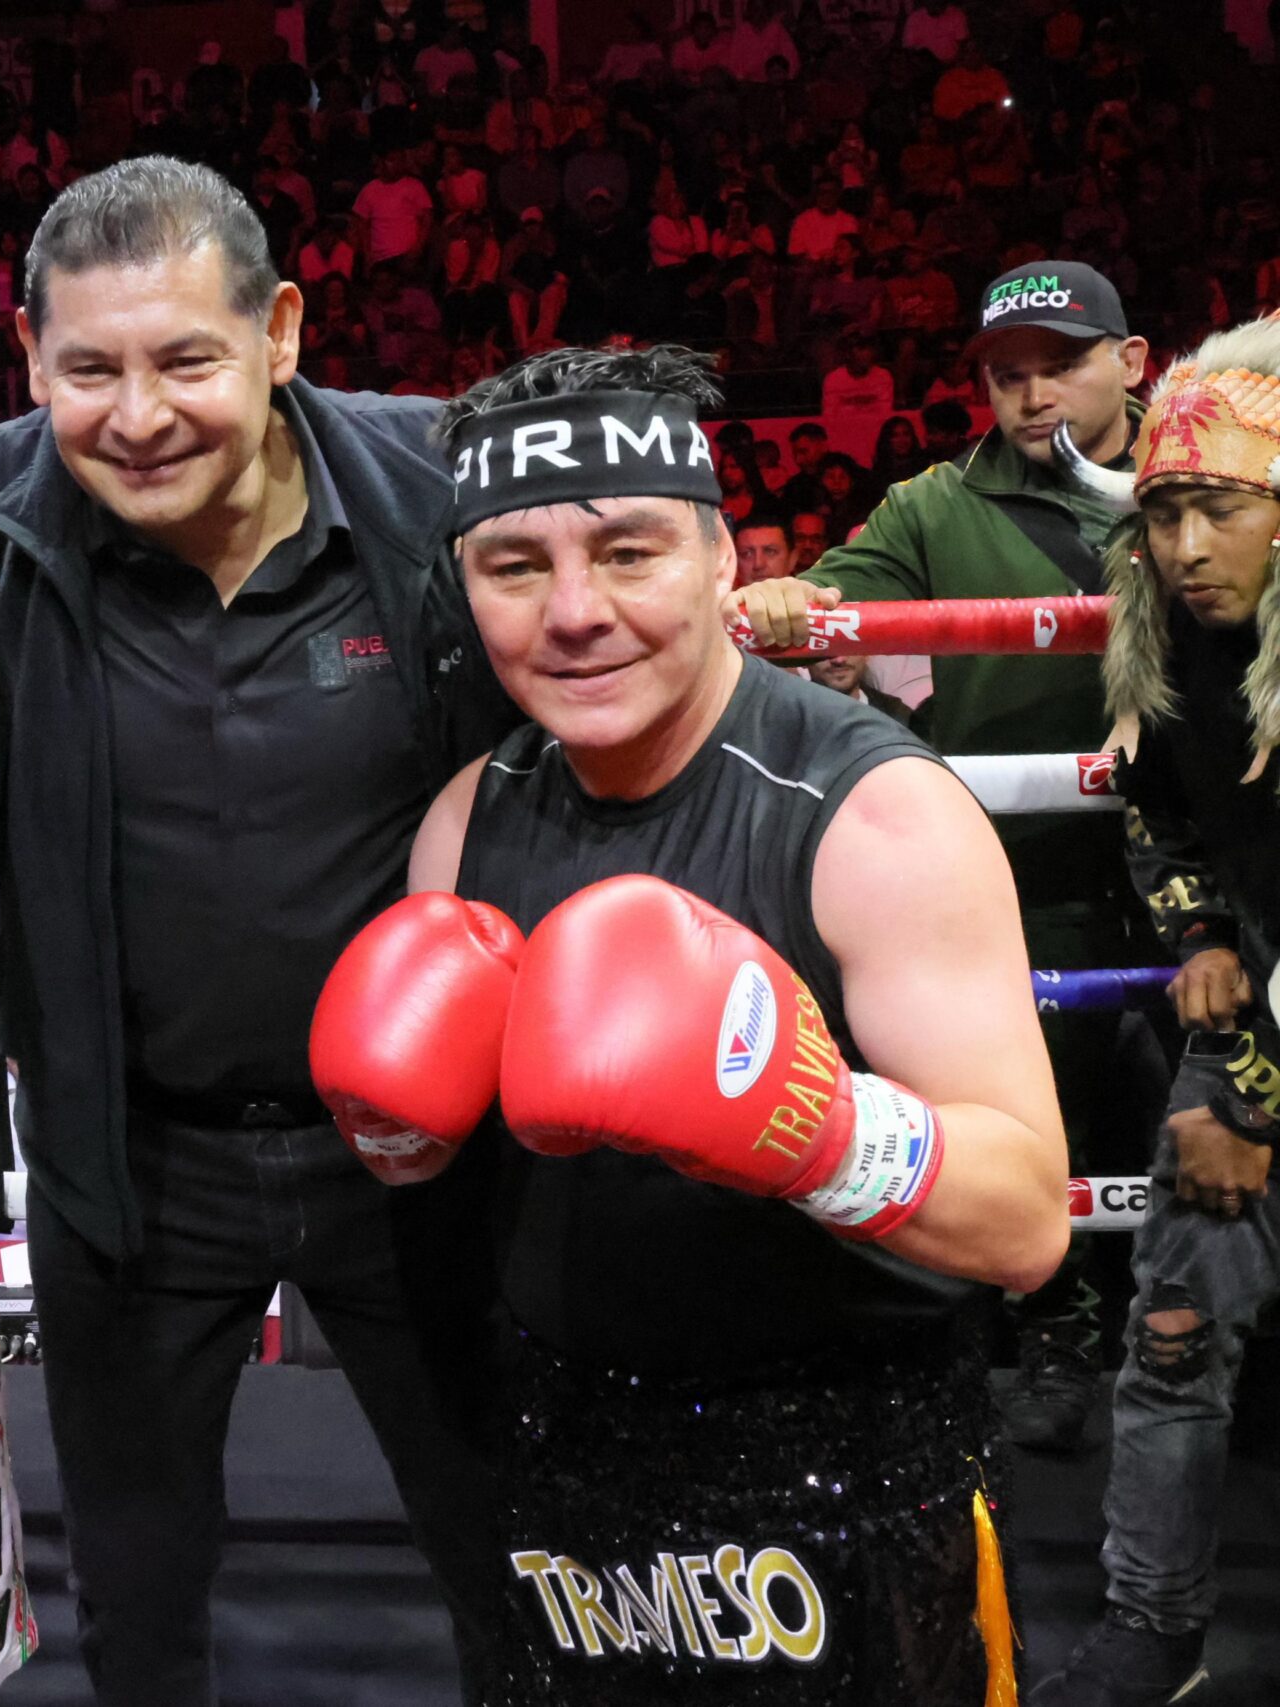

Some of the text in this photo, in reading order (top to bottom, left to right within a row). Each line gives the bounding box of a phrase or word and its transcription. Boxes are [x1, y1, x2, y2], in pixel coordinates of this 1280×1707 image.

[859, 1143, 876, 1172] TITLE
[881, 1133, 897, 1163] TITLE
[510, 1544, 825, 1662] TRAVIESO
